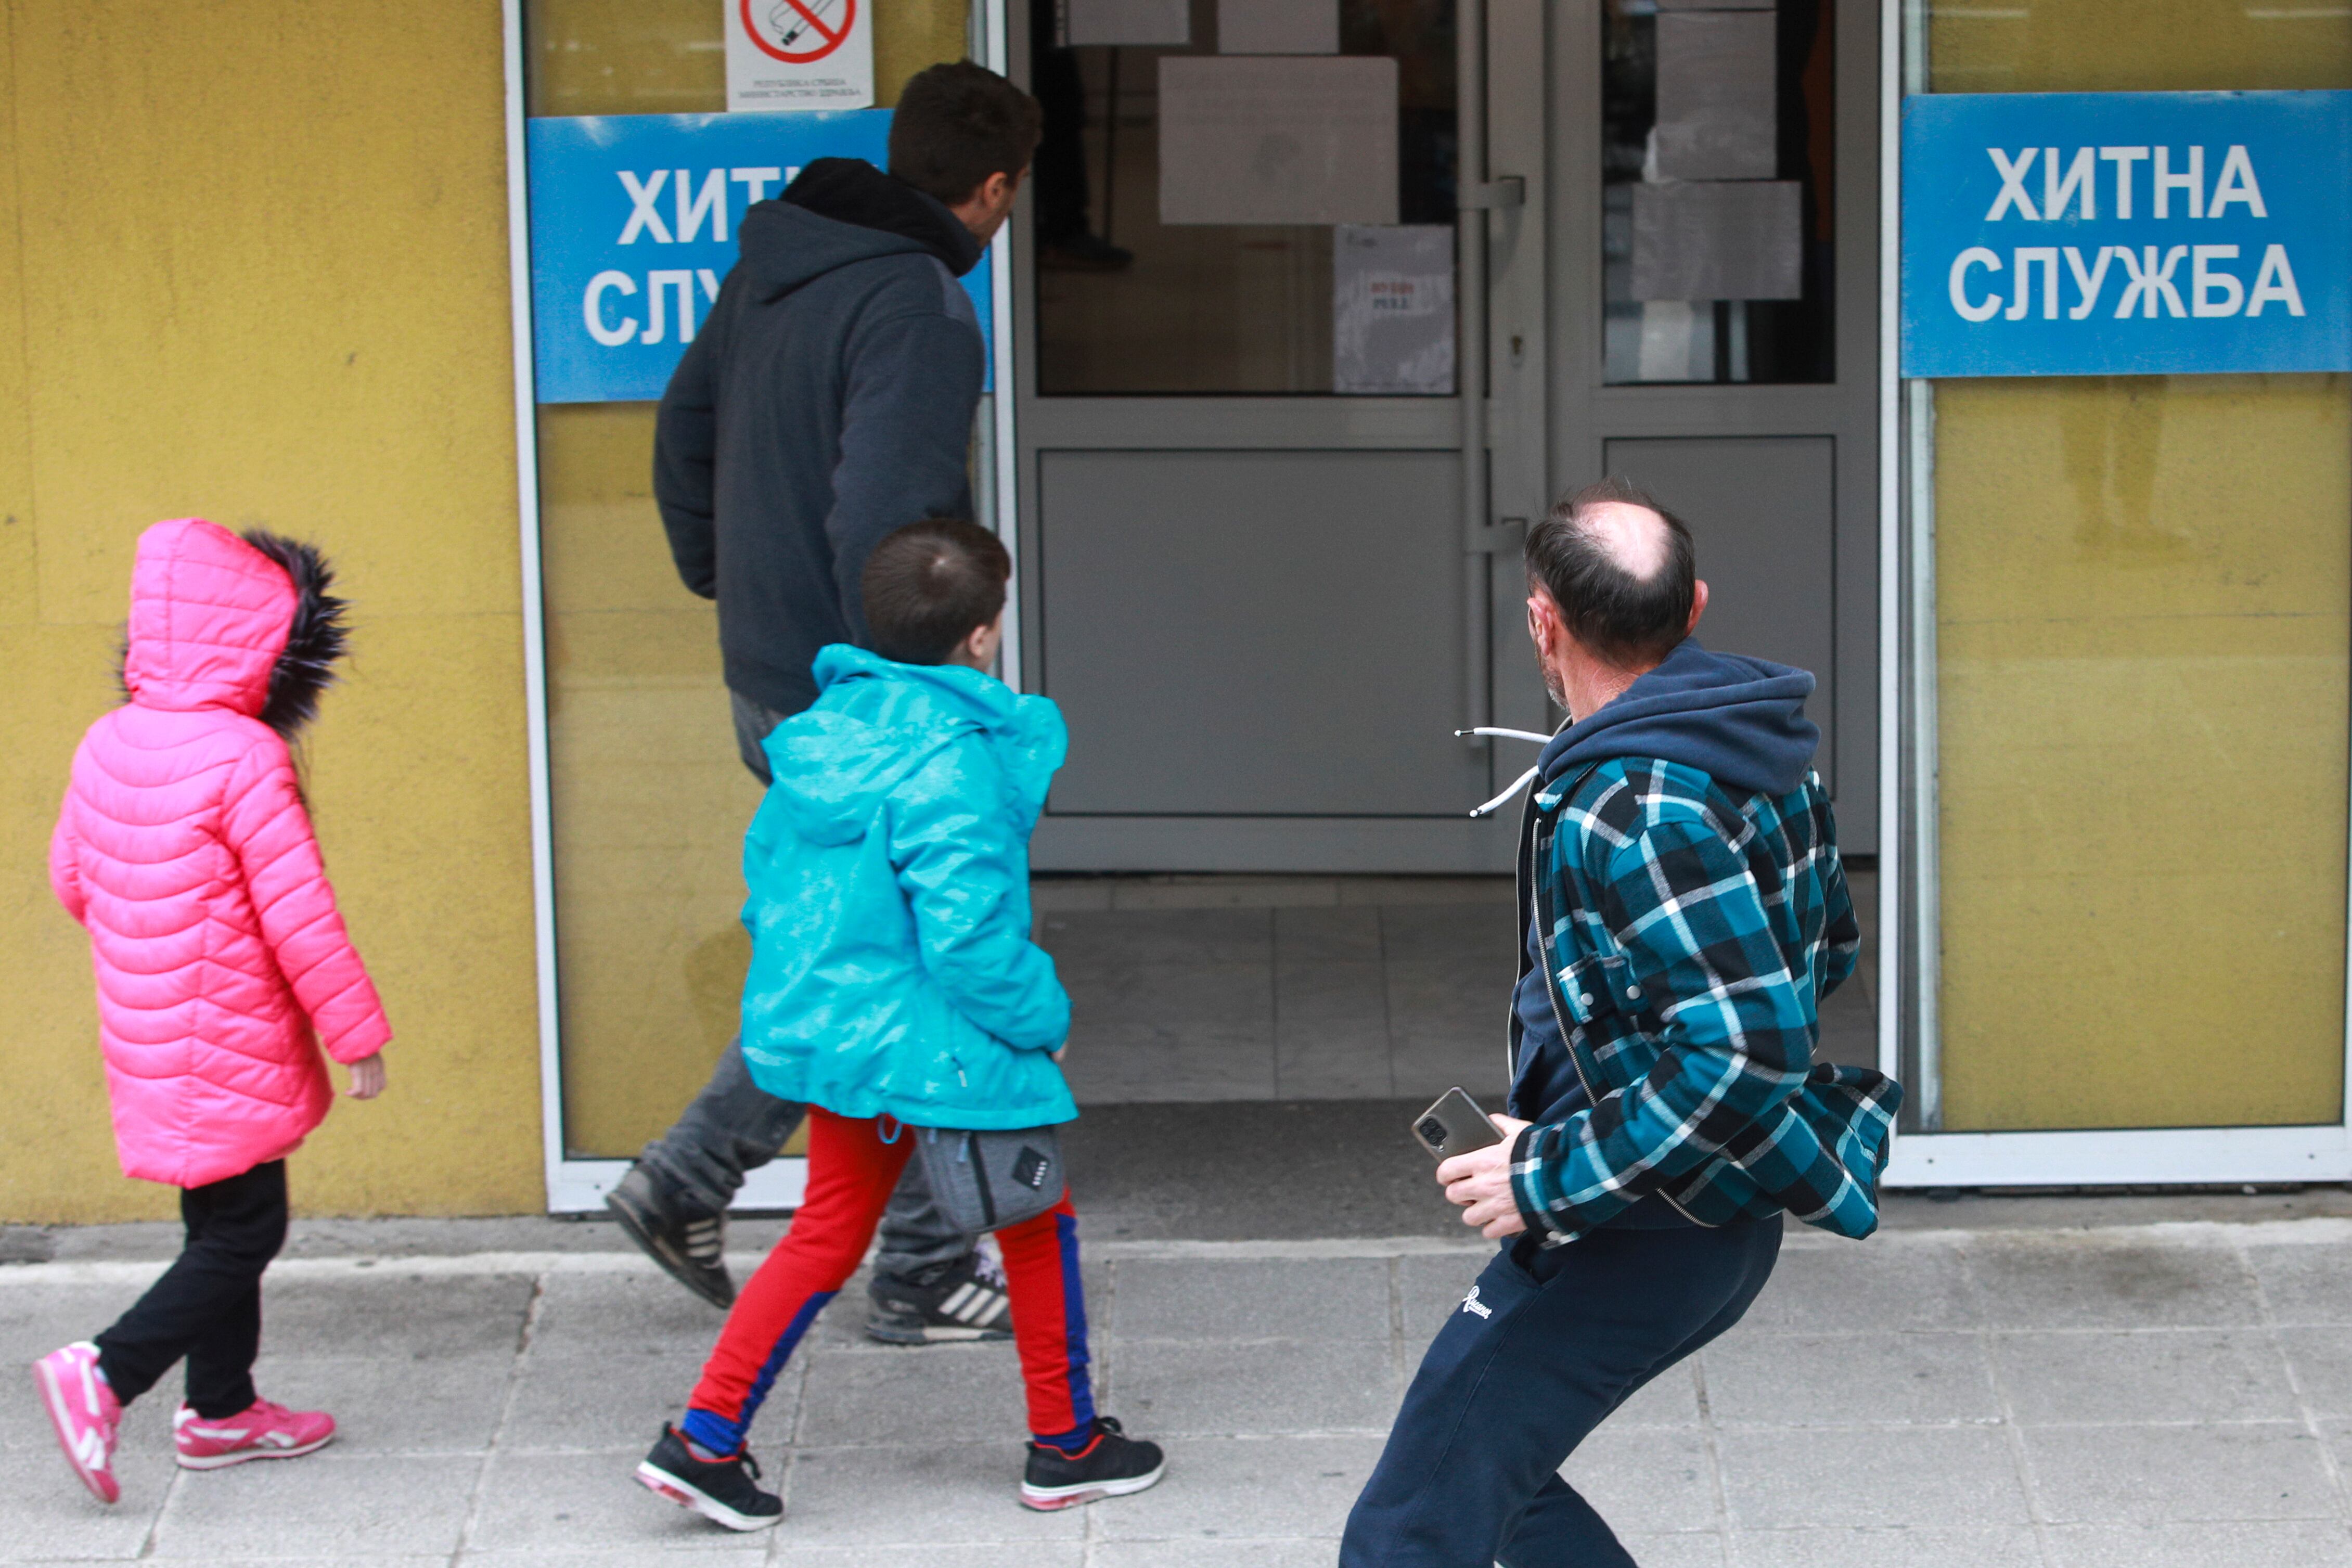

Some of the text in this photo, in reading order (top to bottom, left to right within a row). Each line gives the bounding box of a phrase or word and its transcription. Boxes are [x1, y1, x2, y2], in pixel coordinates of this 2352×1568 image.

[616, 166, 800, 245] ХИТ
[1985, 145, 2268, 221] ХИТНА
[1948, 243, 2306, 322] СЛУЖБА
